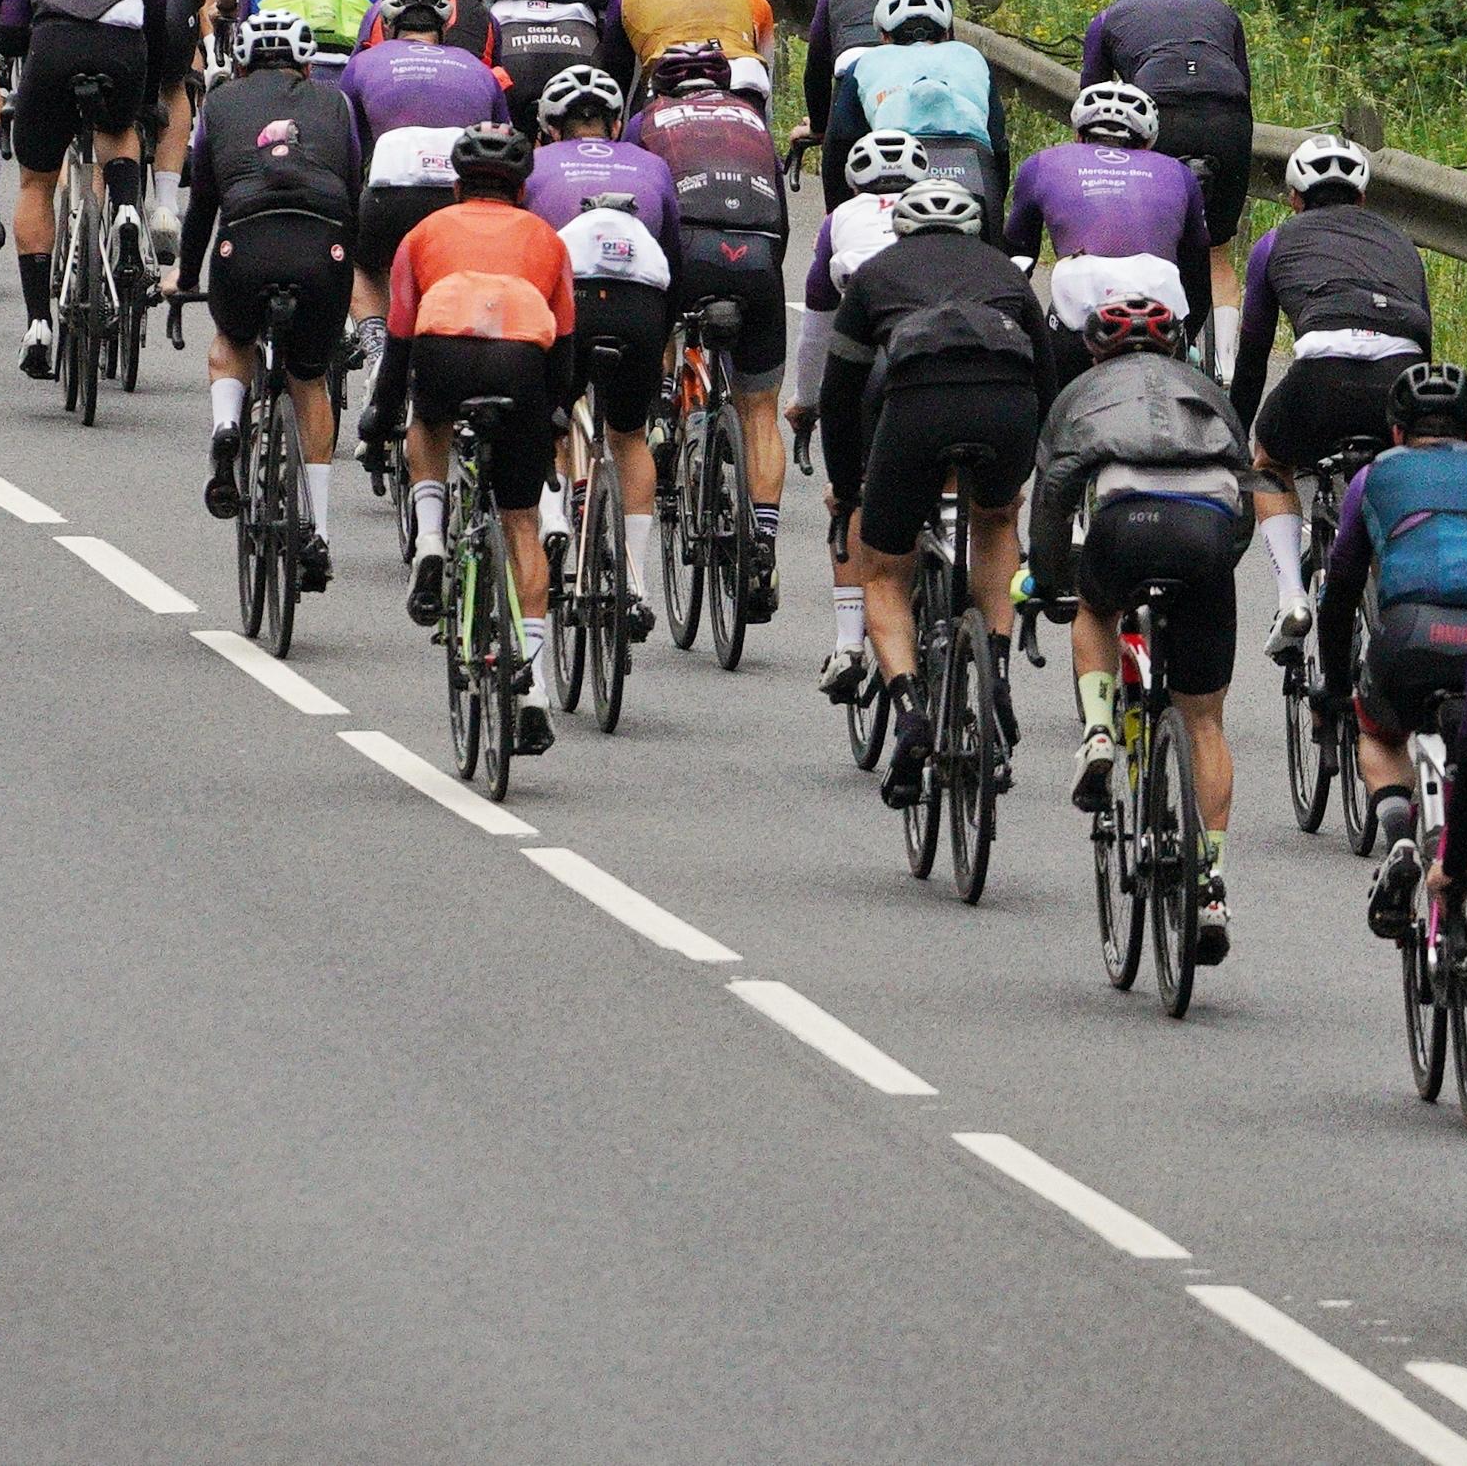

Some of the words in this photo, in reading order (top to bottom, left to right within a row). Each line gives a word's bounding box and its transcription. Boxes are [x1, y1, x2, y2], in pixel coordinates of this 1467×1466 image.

[527, 26, 558, 34] CICLOS
[511, 35, 581, 48] ITURRIAGA
[1078, 168, 1153, 179] Mercedes-Benz
